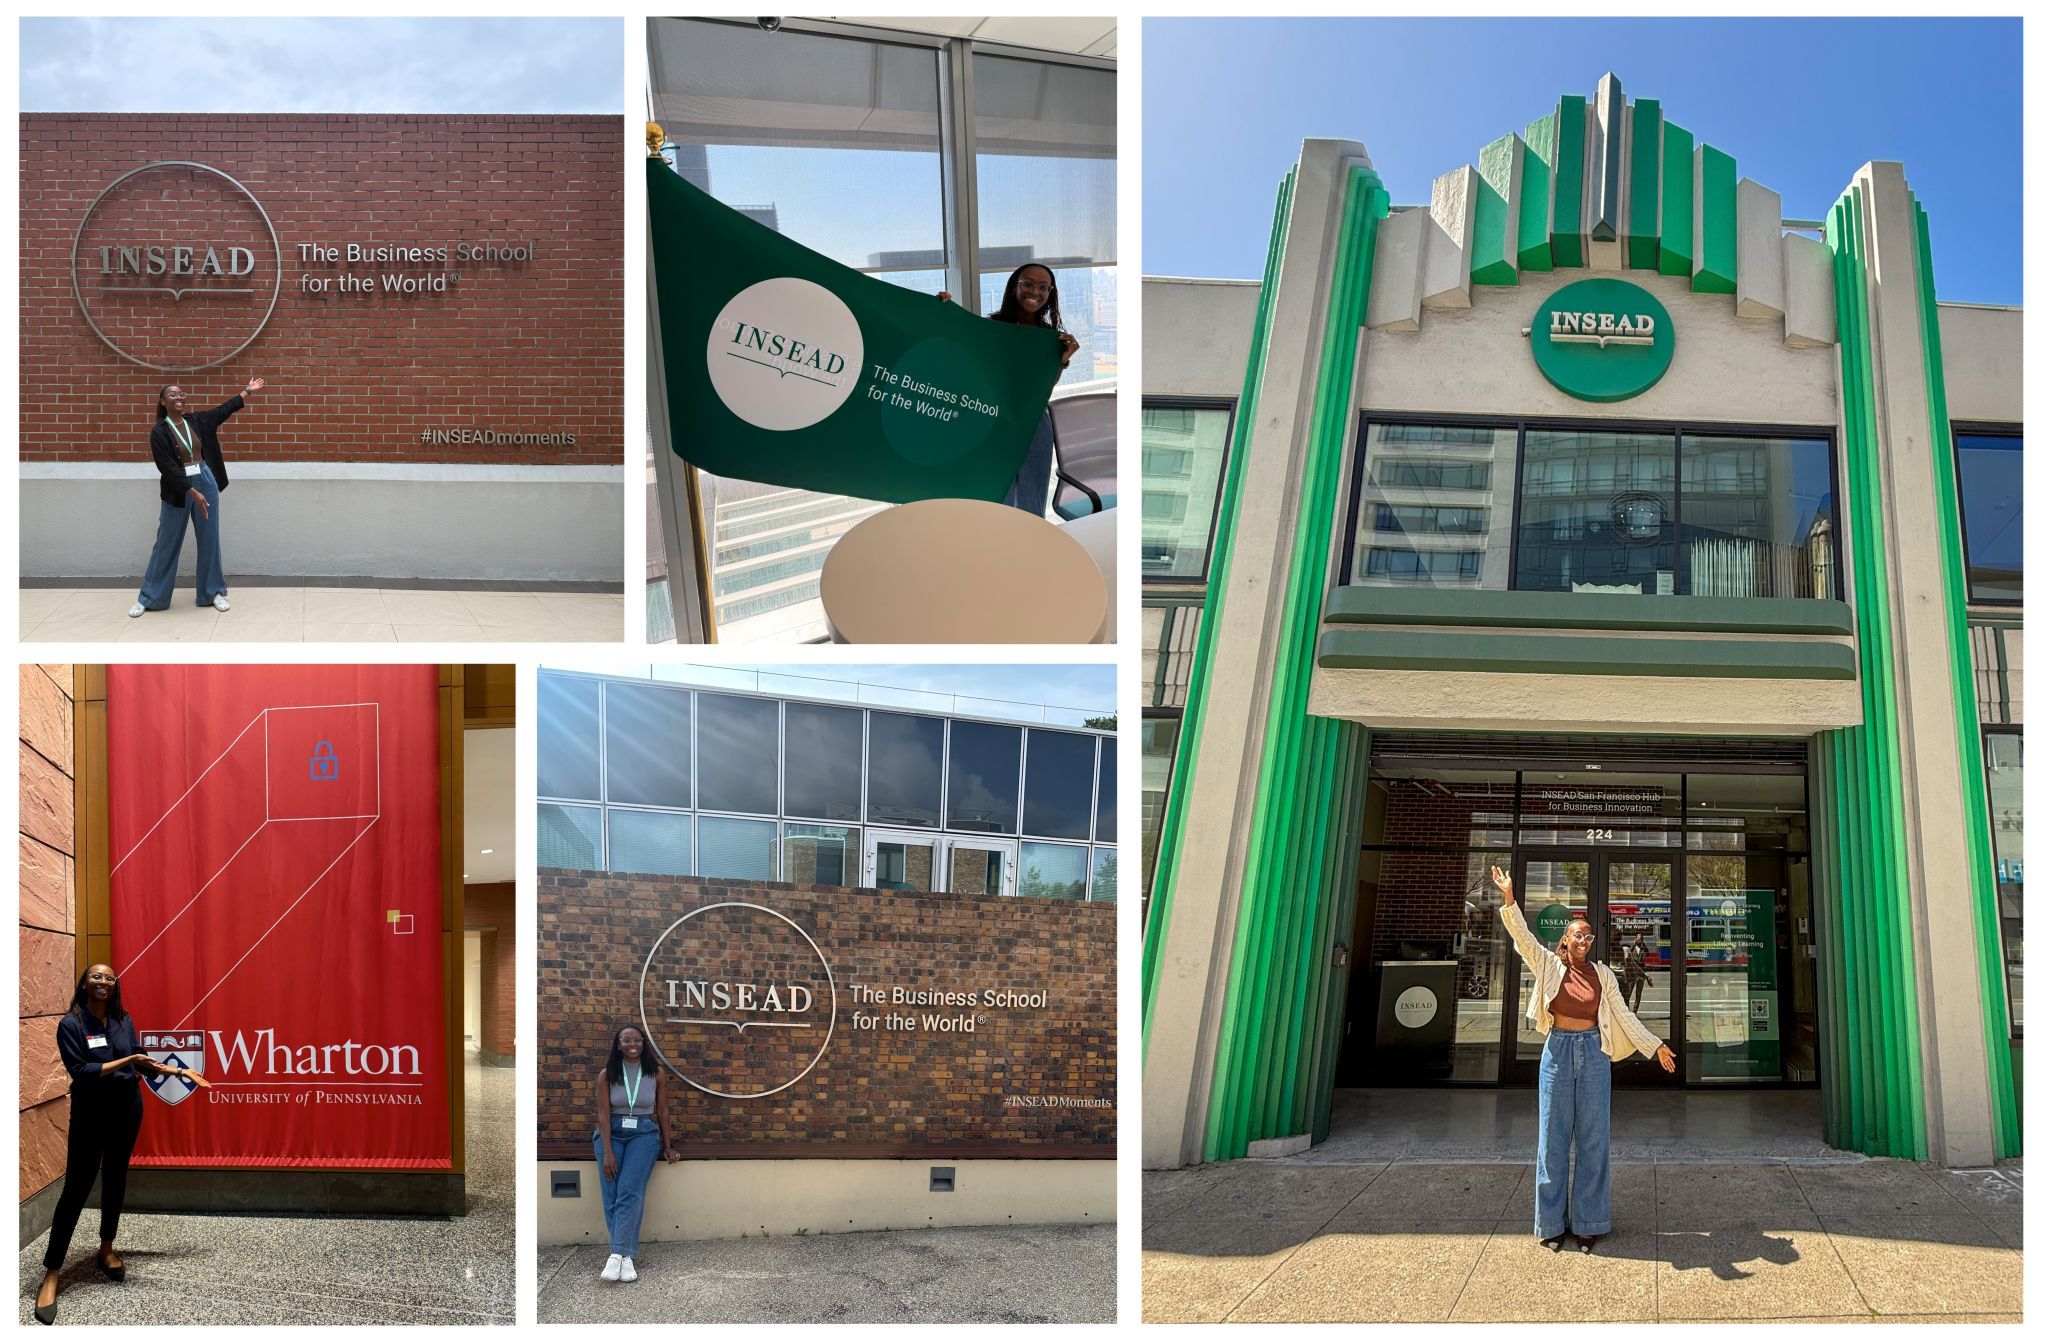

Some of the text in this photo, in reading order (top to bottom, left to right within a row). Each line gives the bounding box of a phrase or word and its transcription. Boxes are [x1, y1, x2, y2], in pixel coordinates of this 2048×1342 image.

[99, 245, 255, 276] INSEAD
[297, 241, 534, 262] The Business School
[301, 273, 334, 293] for
[338, 272, 374, 292] the
[1550, 310, 1655, 336] INSEAD
[731, 321, 846, 376] INSEAD
[866, 384, 889, 402] for
[890, 392, 913, 411] the
[873, 364, 999, 418] The Business School
[420, 428, 577, 445] #INSEADmoments
[1541, 790, 1661, 801] INSEAD San Francisco Hub
[1548, 801, 1653, 812] for Business Innovation
[1586, 828, 1613, 840] 224
[1540, 918, 1570, 926] INSEAD
[665, 979, 813, 1013] INSEAD
[849, 984, 1048, 1008] The Business School
[1400, 1002, 1433, 1010] INSEAD
[852, 1011, 880, 1030] for
[884, 1012, 916, 1031] the
[207, 1027, 424, 1075] Wharton
[208, 1090, 423, 1107] UNIVERSITY of PENNSYLVANIA
[1003, 1095, 1113, 1109] #INSEADMoments
